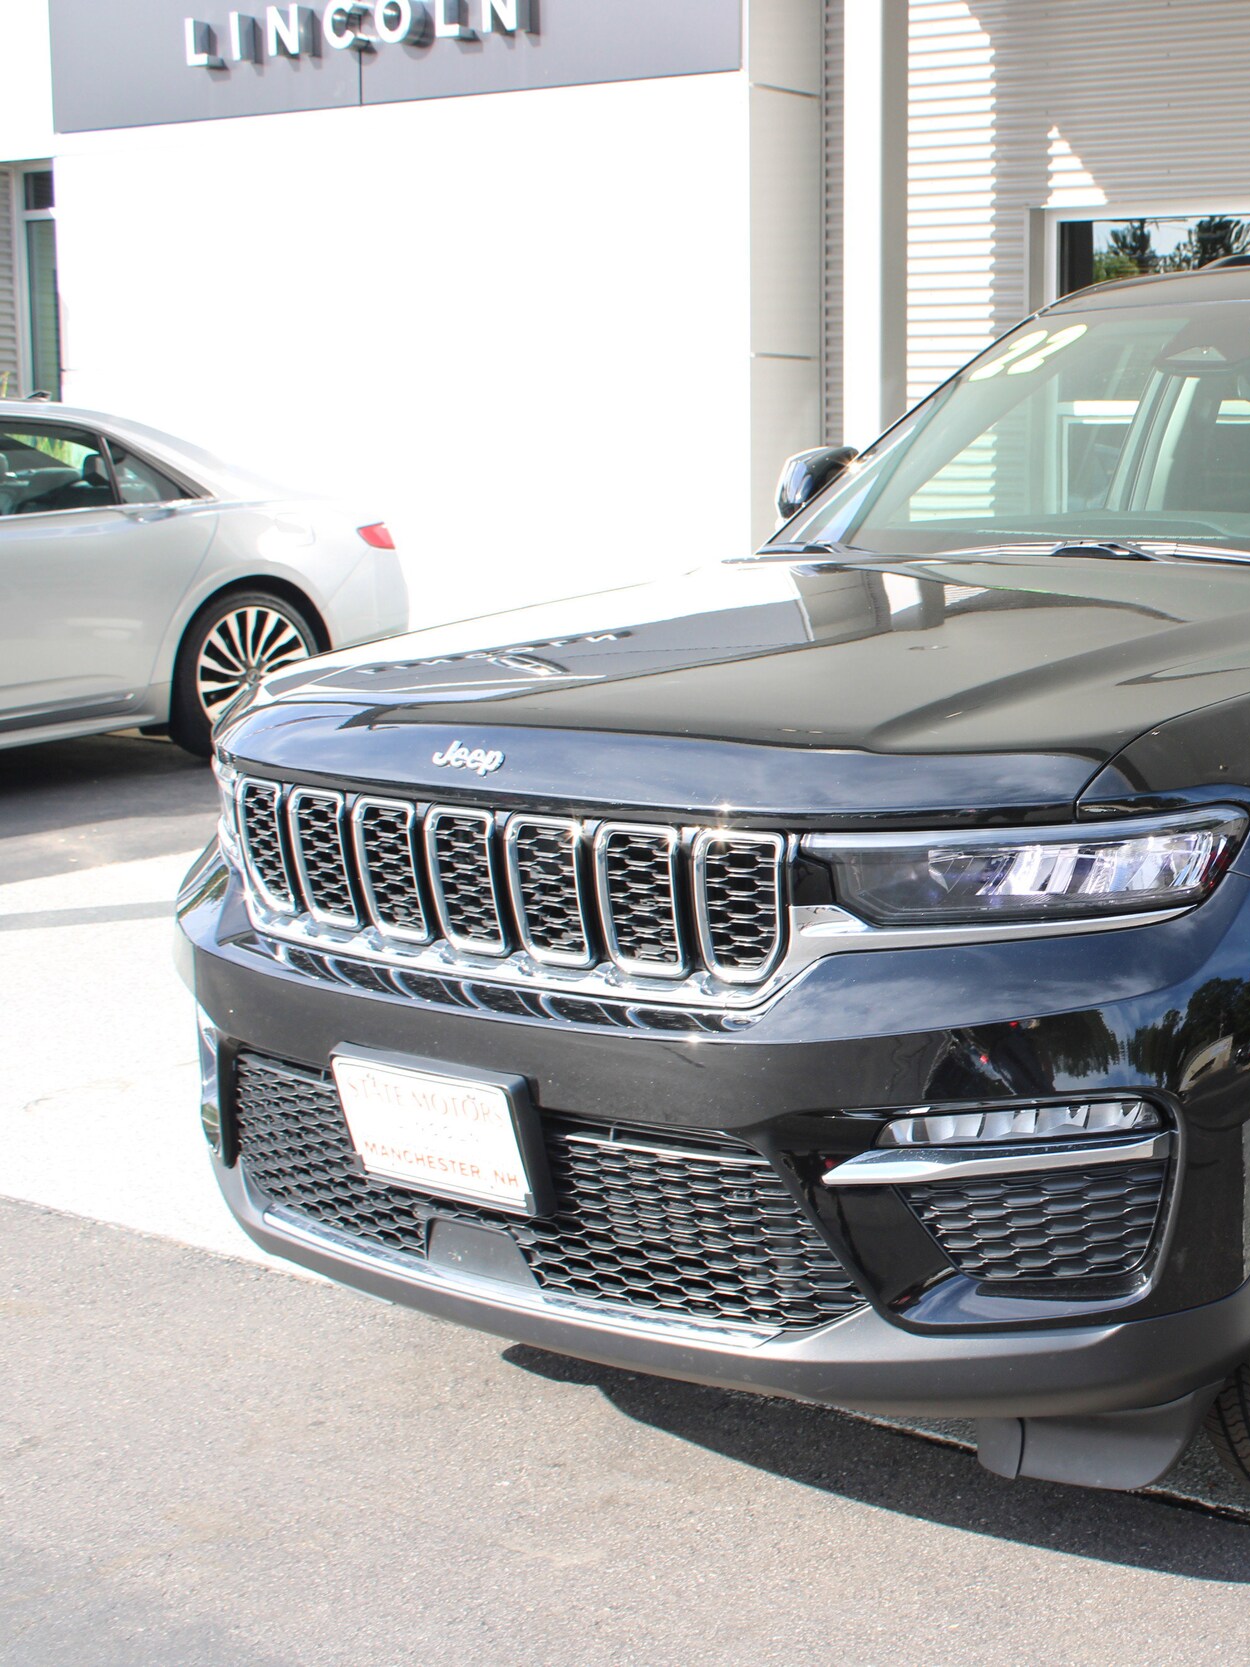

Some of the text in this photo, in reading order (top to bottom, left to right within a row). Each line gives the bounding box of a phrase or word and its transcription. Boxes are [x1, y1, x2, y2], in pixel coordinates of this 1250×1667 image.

[185, 0, 520, 67] LINCOLN
[968, 324, 1088, 382] 22
[432, 740, 505, 776] Jeep
[493, 1169, 520, 1188] NH
